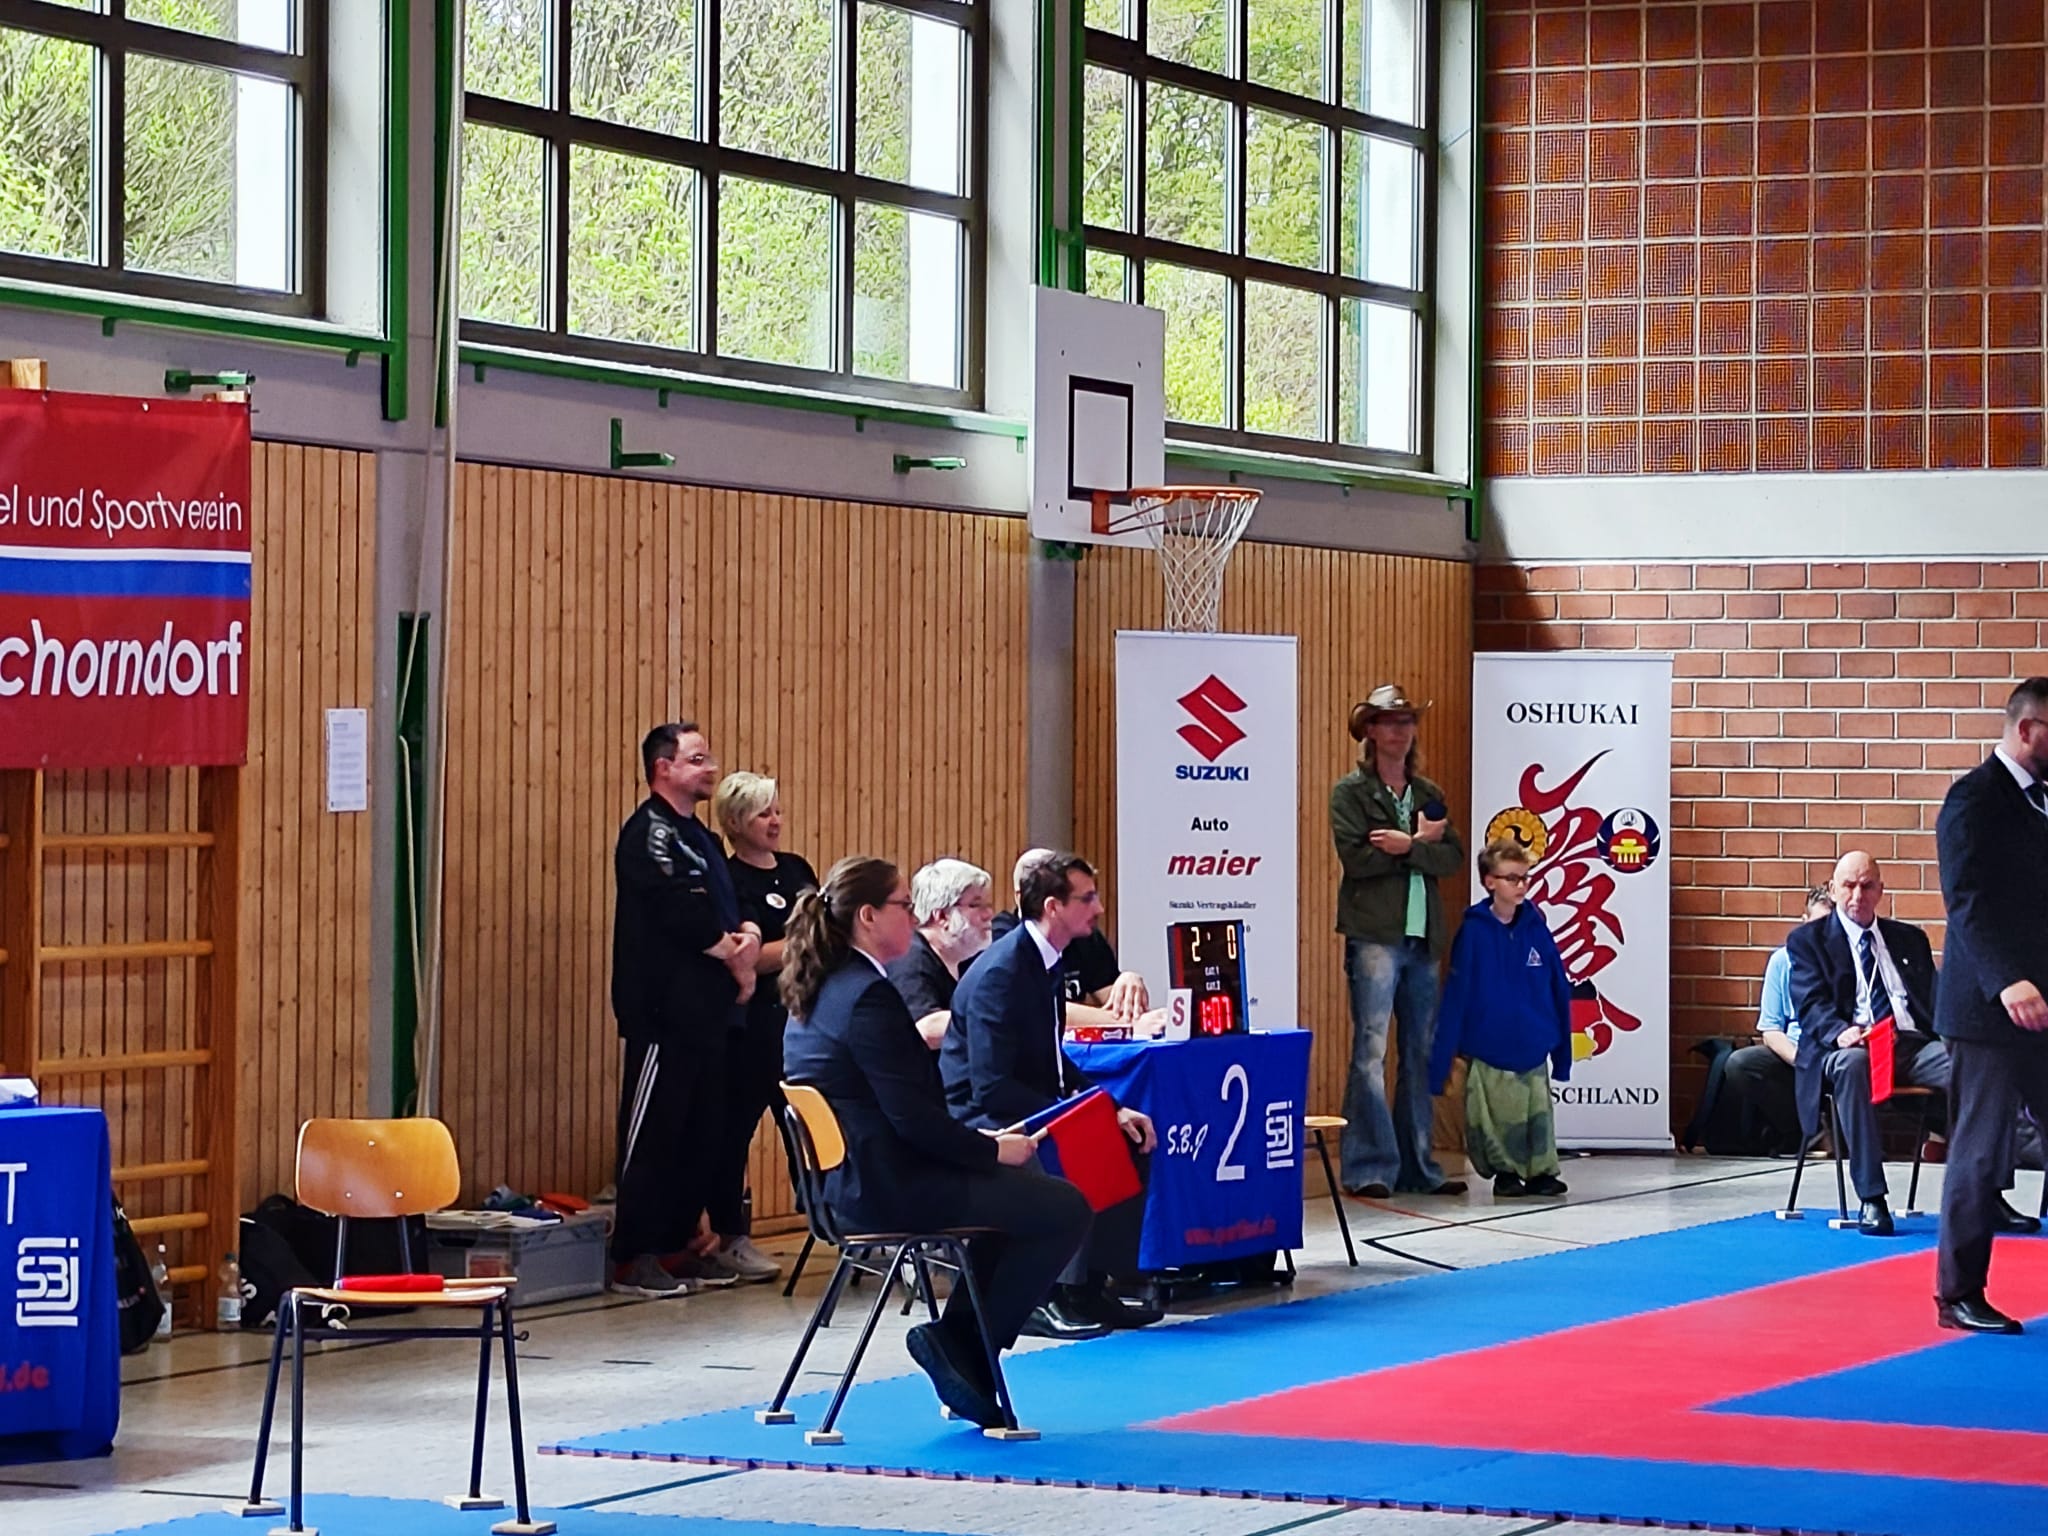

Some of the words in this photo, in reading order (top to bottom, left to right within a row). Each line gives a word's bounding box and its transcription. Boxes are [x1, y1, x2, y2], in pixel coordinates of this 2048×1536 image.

[28, 488, 84, 527] und
[90, 489, 242, 538] Sportverein
[0, 619, 242, 697] chorndorf
[1506, 702, 1640, 725] OSHUKAI
[1175, 764, 1249, 781] SUZUKI
[1191, 817, 1229, 832] Auto
[1167, 849, 1261, 876] maier
[1190, 926, 1202, 962] 2
[1226, 925, 1237, 960] 0
[1172, 996, 1185, 1027] S
[1216, 1063, 1249, 1182] 2
